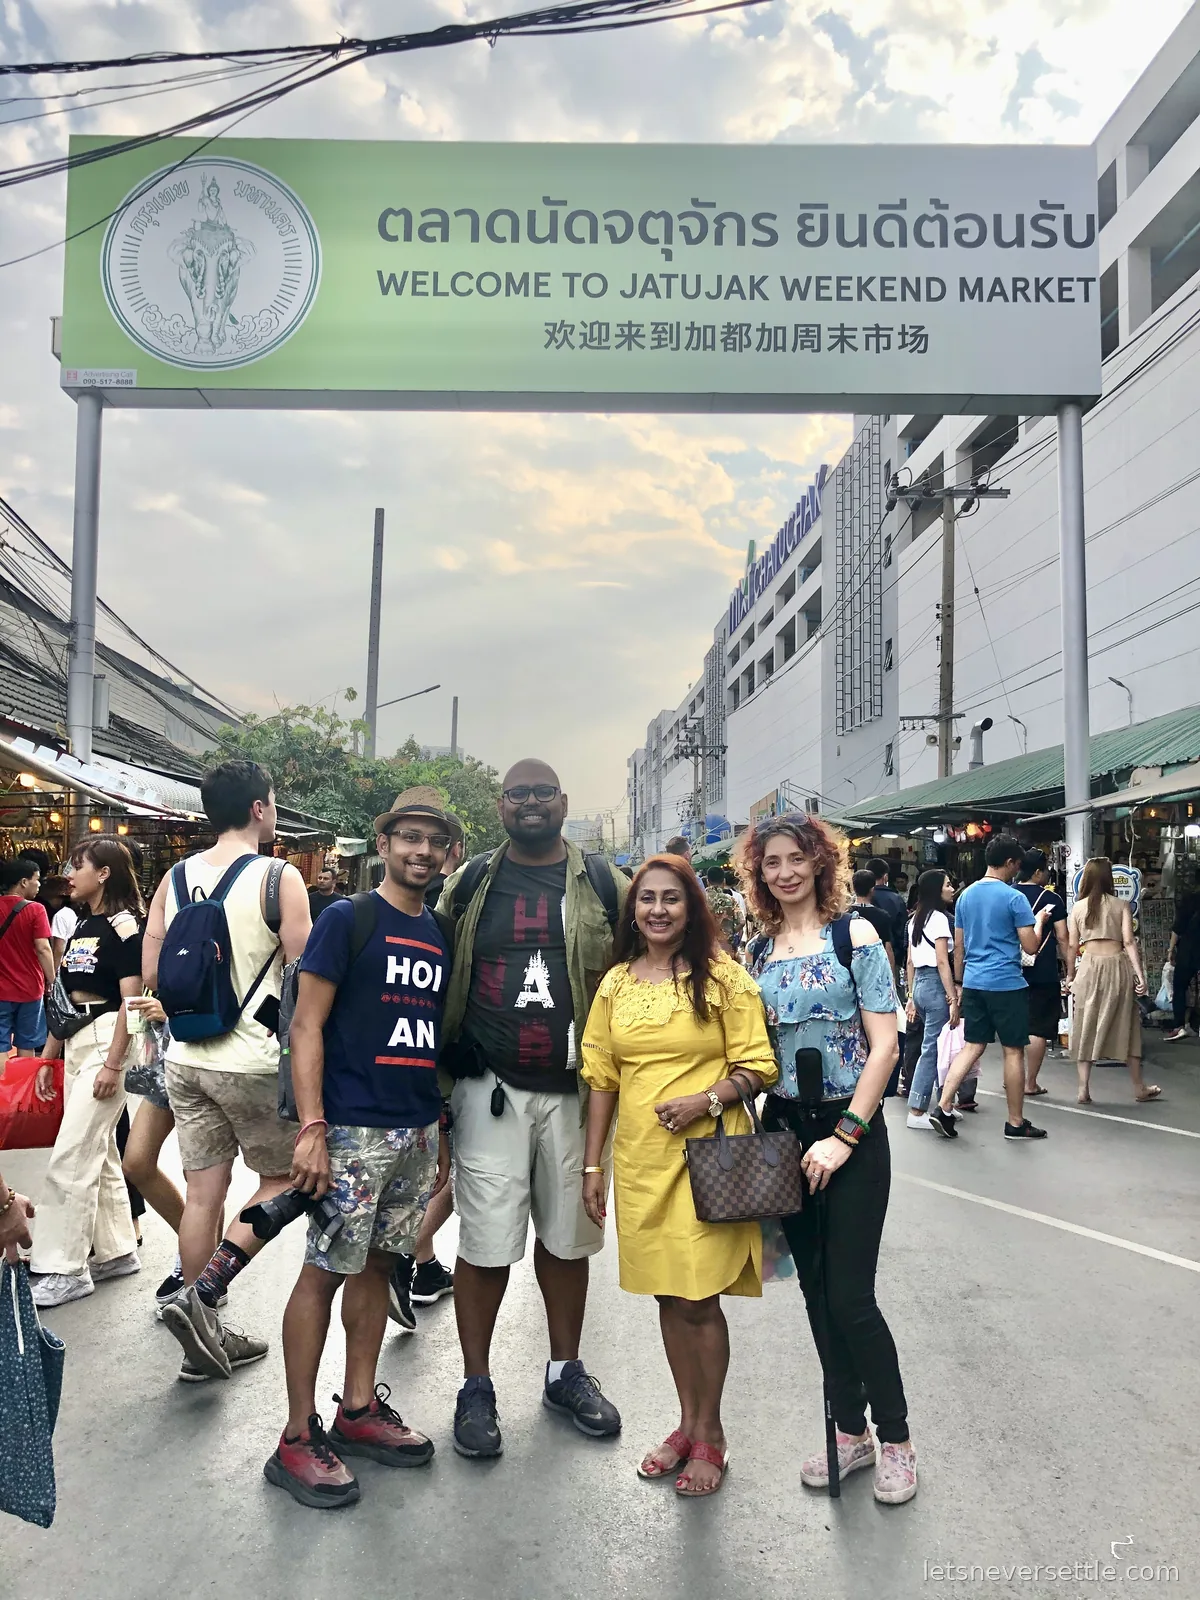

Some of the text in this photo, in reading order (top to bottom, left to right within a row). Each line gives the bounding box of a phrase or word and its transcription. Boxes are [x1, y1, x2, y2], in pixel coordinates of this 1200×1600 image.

[377, 195, 1096, 261] ตลาดนัดจตุจักร ยินดีต้อนรับ
[376, 270, 1097, 304] WELCOME TO JATUJAK WEEKEND MARKET
[543, 319, 930, 355] 欢迎来到加都加周末市场
[385, 955, 443, 993] HOI
[386, 1017, 435, 1050] AN
